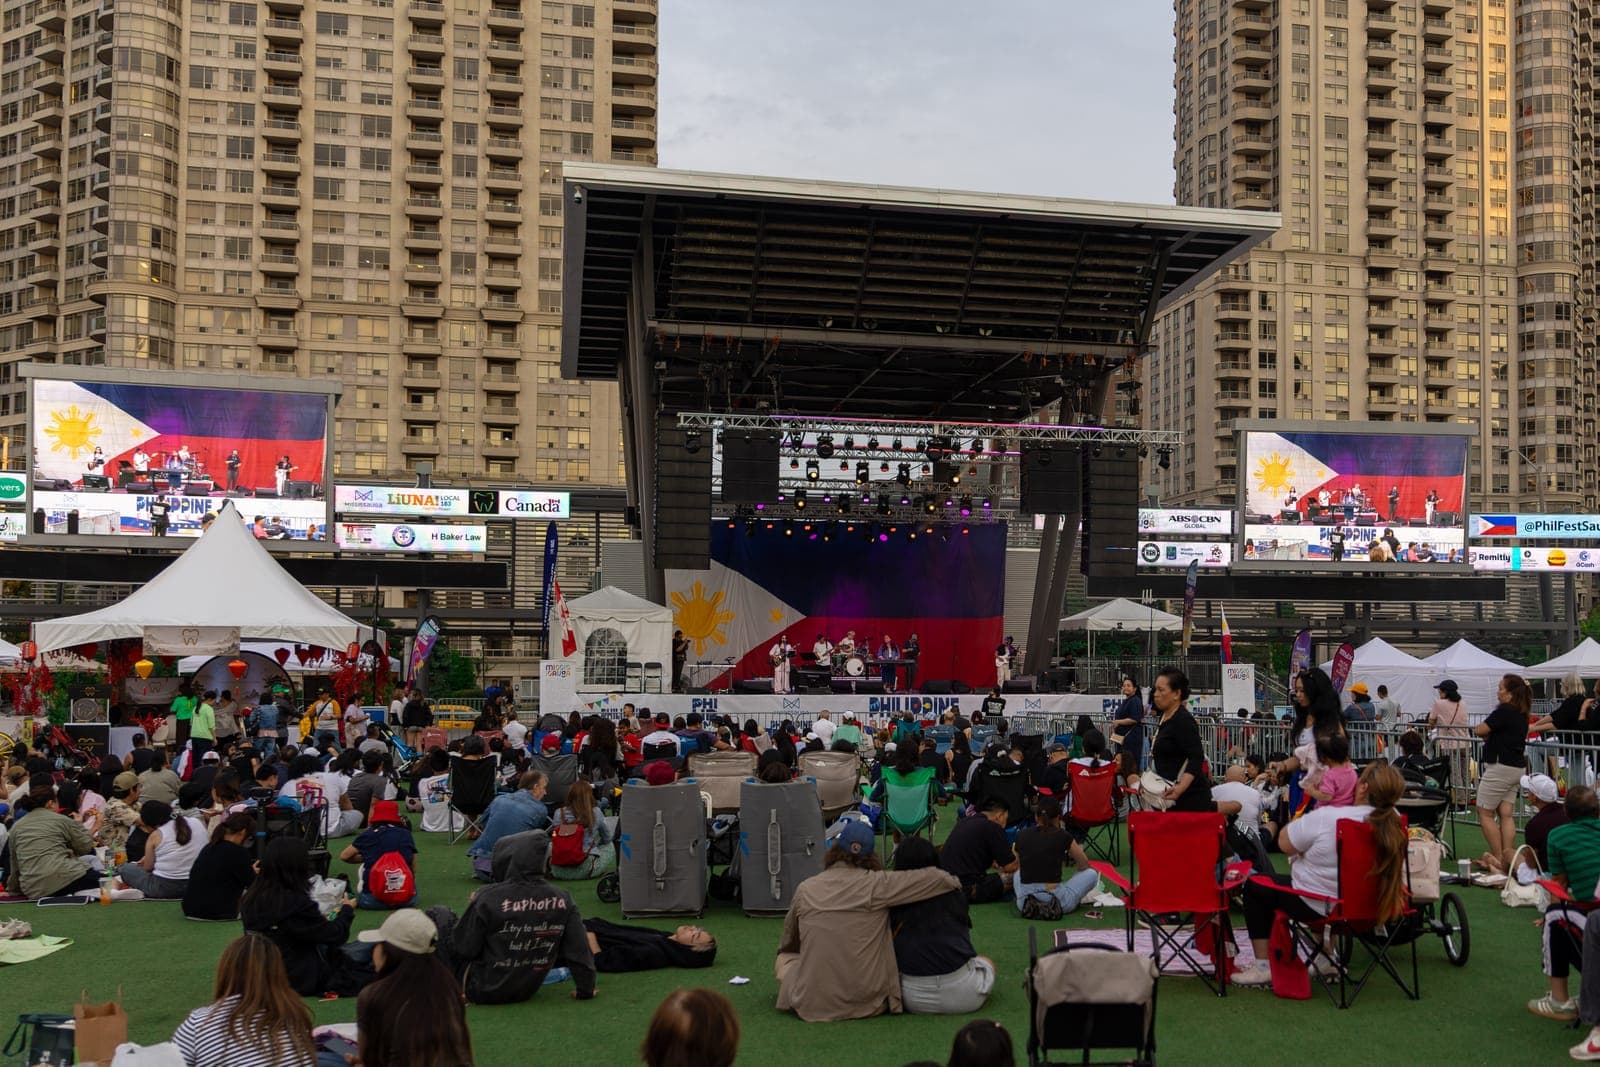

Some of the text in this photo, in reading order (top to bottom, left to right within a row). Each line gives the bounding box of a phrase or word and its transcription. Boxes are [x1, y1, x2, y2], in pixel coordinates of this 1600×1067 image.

[136, 496, 212, 514] PHPPINE
[387, 493, 440, 506] LiUNA!
[505, 497, 561, 513] Canada
[440, 533, 463, 541] Baker
[1320, 527, 1377, 542] PHPPINE
[1479, 553, 1511, 562] Remitly
[692, 698, 718, 712] PHI
[510, 924, 521, 938] try
[524, 924, 532, 932] to
